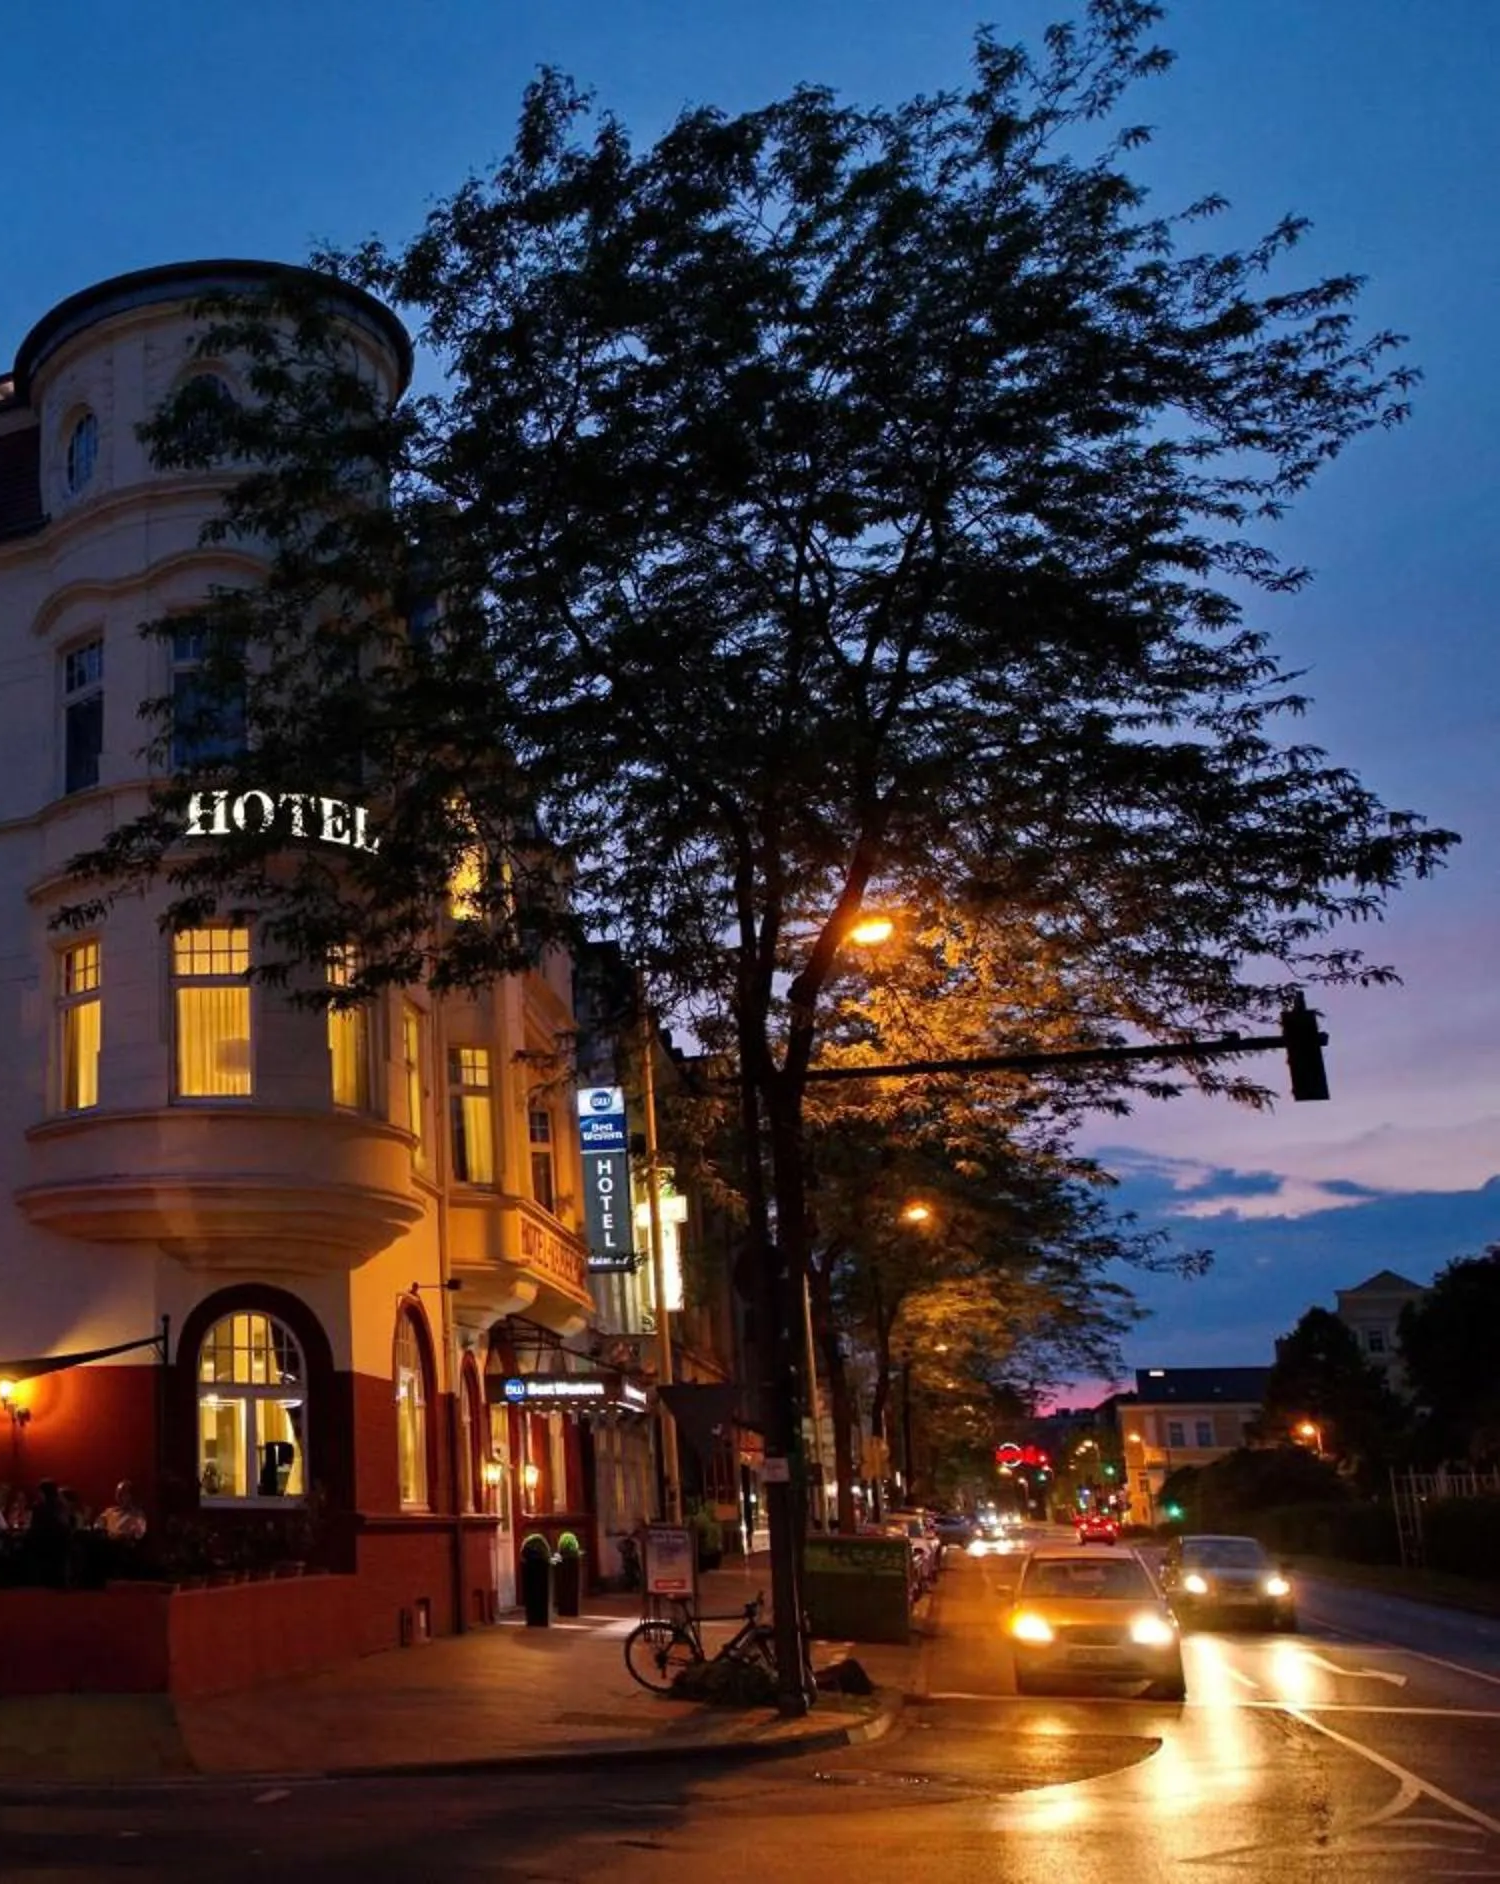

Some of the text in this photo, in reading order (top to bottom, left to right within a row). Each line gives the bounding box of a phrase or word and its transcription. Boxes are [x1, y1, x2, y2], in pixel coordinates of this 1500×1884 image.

[185, 790, 379, 855] HOTEL
[597, 1159, 617, 1248] HOTEL
[527, 1382, 554, 1396] Best
[555, 1382, 605, 1396] Western
